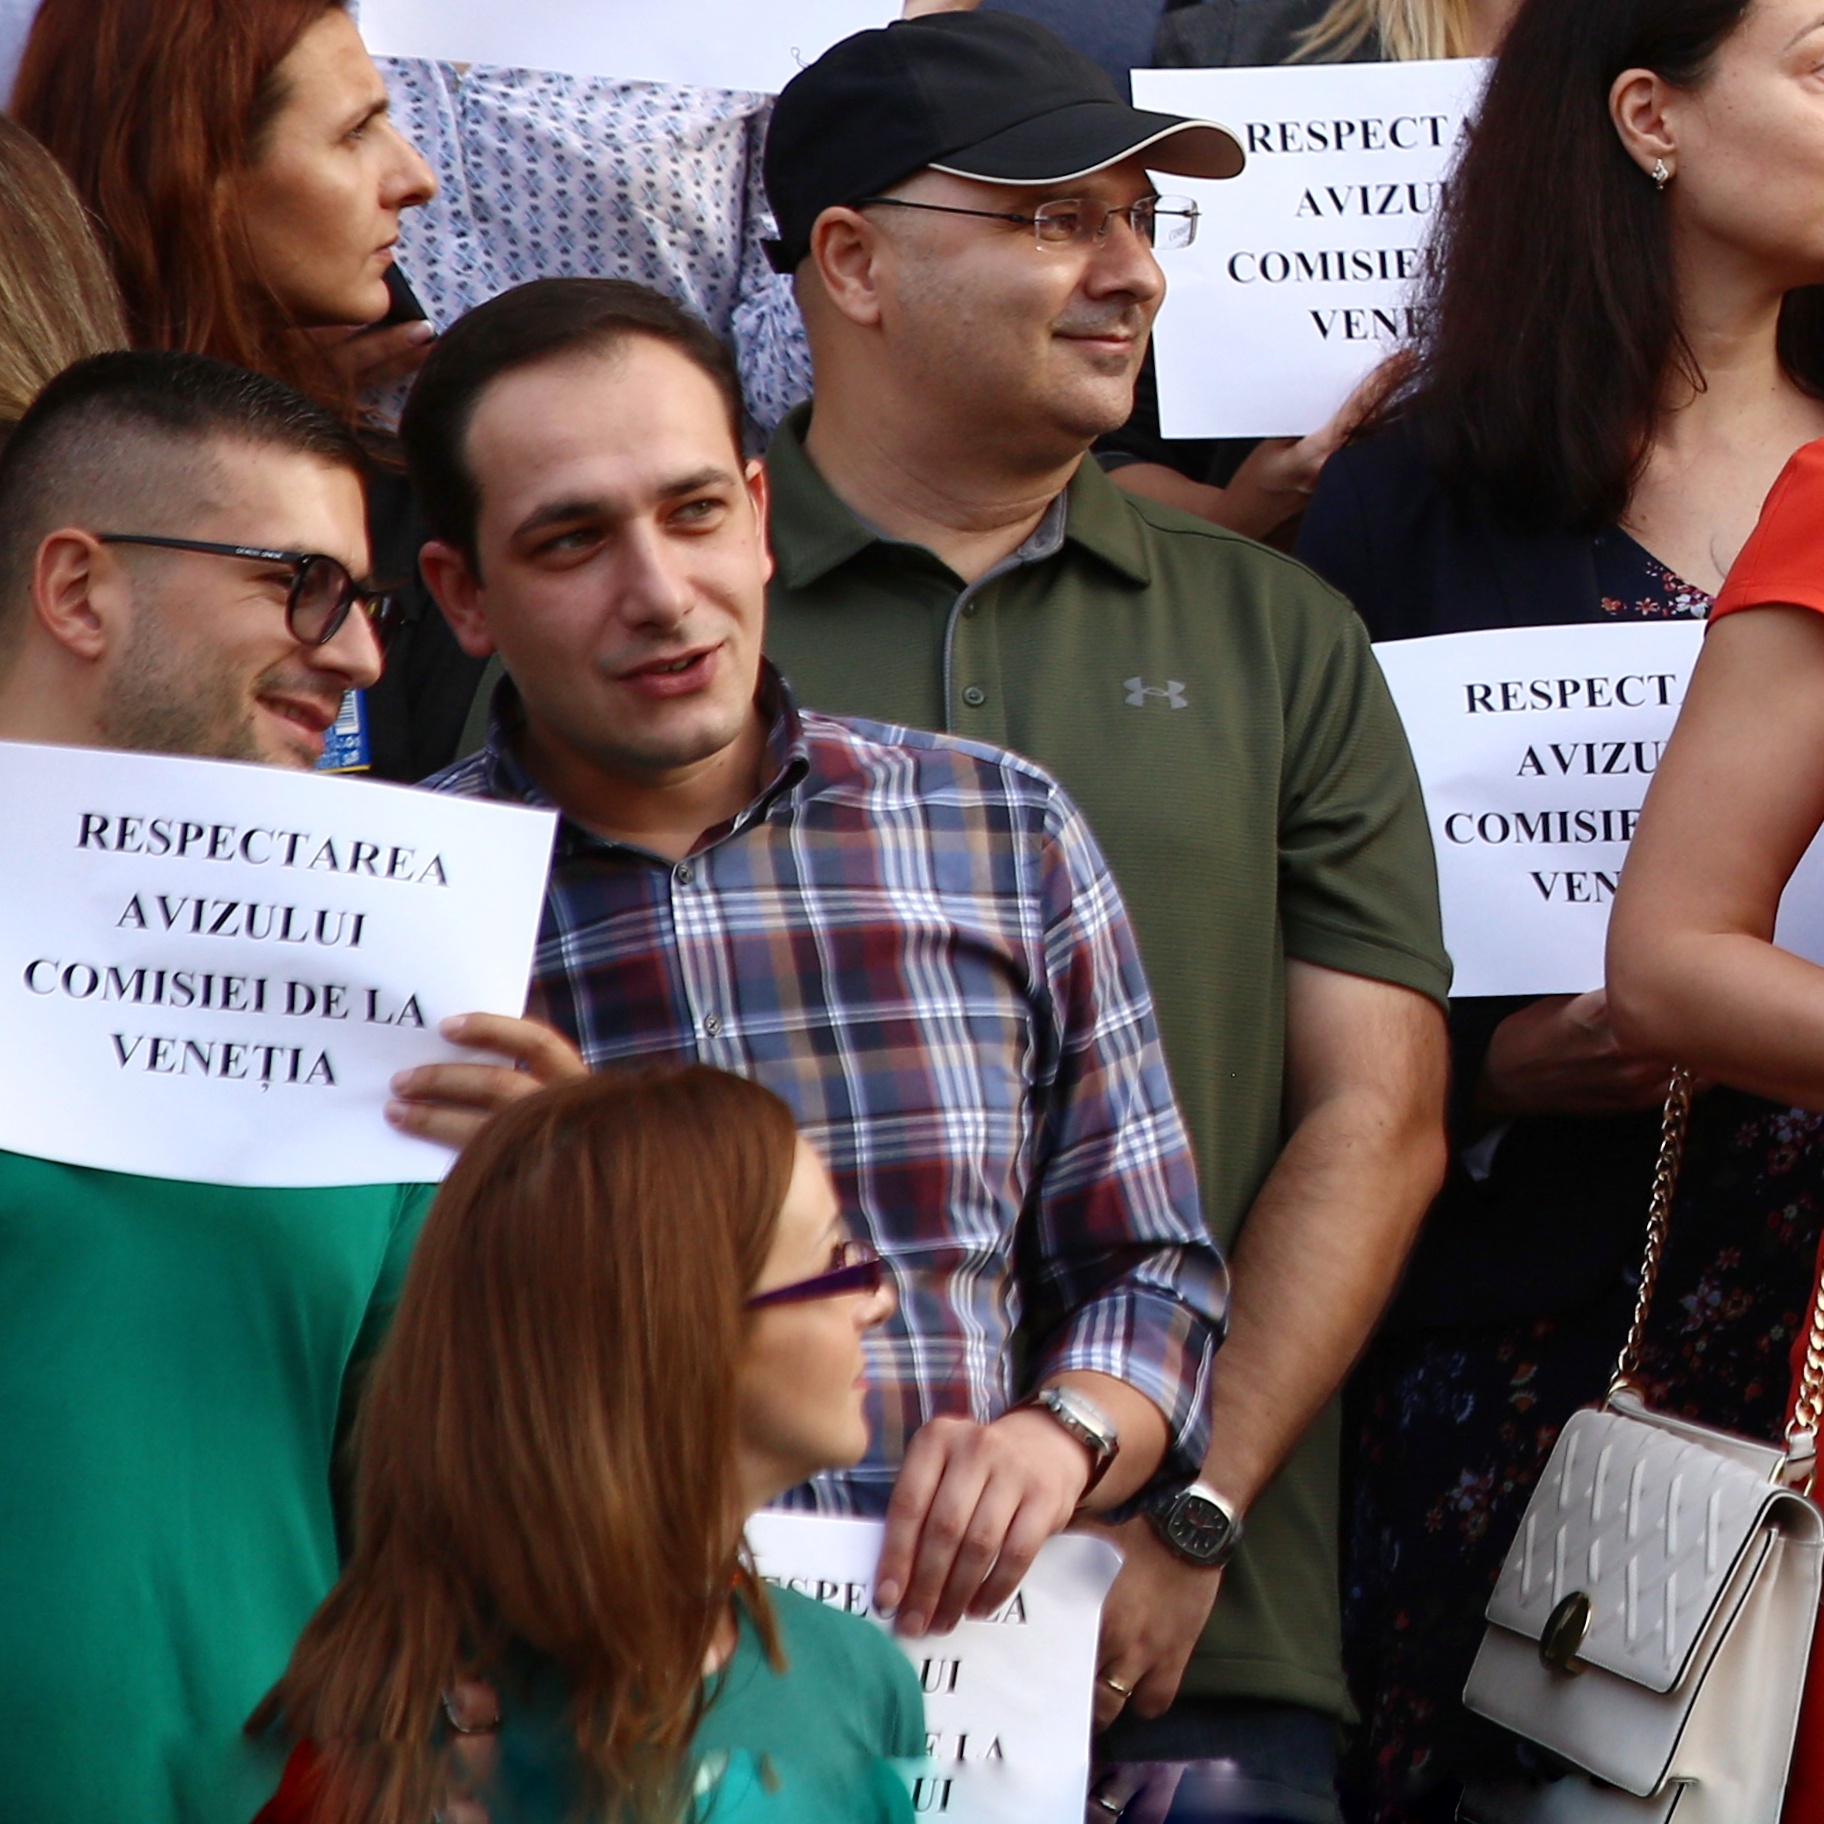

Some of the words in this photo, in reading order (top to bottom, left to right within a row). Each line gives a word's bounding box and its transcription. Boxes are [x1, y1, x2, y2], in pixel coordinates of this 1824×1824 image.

[1464, 674, 1686, 715] RESPECT
[76, 813, 450, 888] RESPECTAREA
[115, 893, 367, 949] AVIZULUI
[23, 958, 268, 1013] COMISIEI
[283, 981, 351, 1020] DE
[366, 989, 427, 1029] LA
[109, 1034, 338, 1093] VENEȚIA
